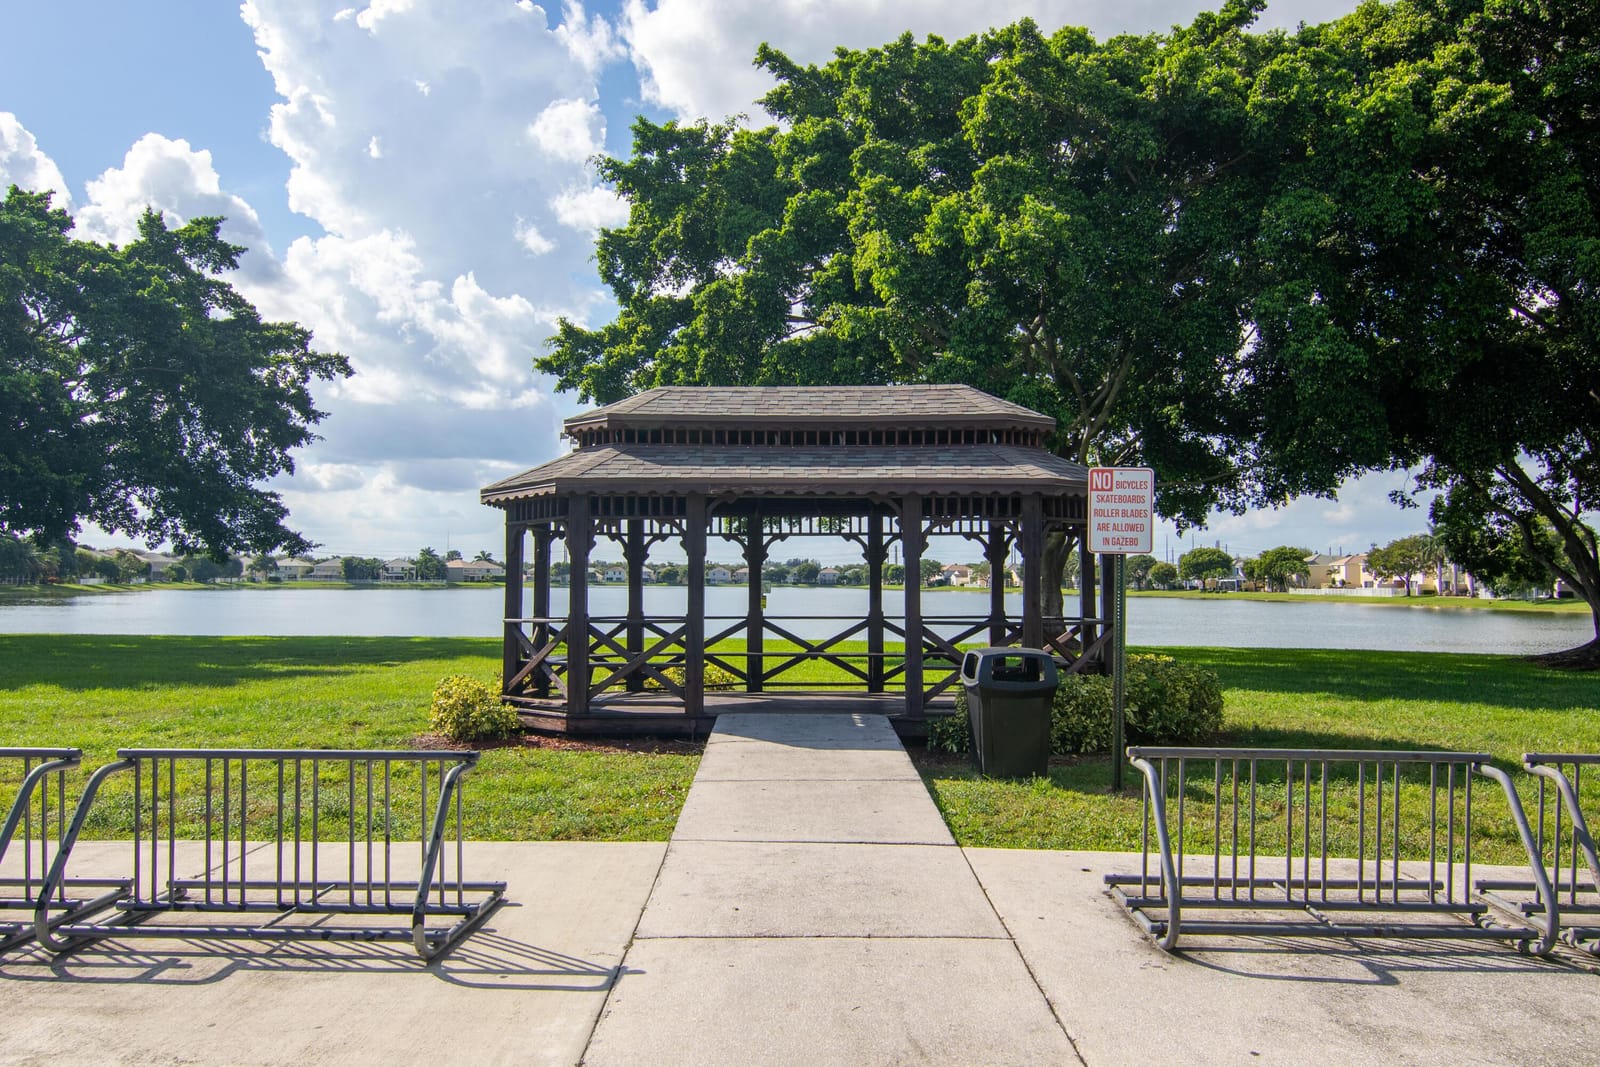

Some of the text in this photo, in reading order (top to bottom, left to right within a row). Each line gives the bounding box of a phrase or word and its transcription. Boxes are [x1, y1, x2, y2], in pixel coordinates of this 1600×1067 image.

[1092, 472, 1148, 490] NO BICYCLES
[1096, 494, 1146, 503] SKATEBOARDS
[1094, 509, 1148, 518] ROLLER BLADES
[1097, 523, 1144, 532] ARE ALLOWED
[1103, 537, 1138, 546] IN GAZEBO
